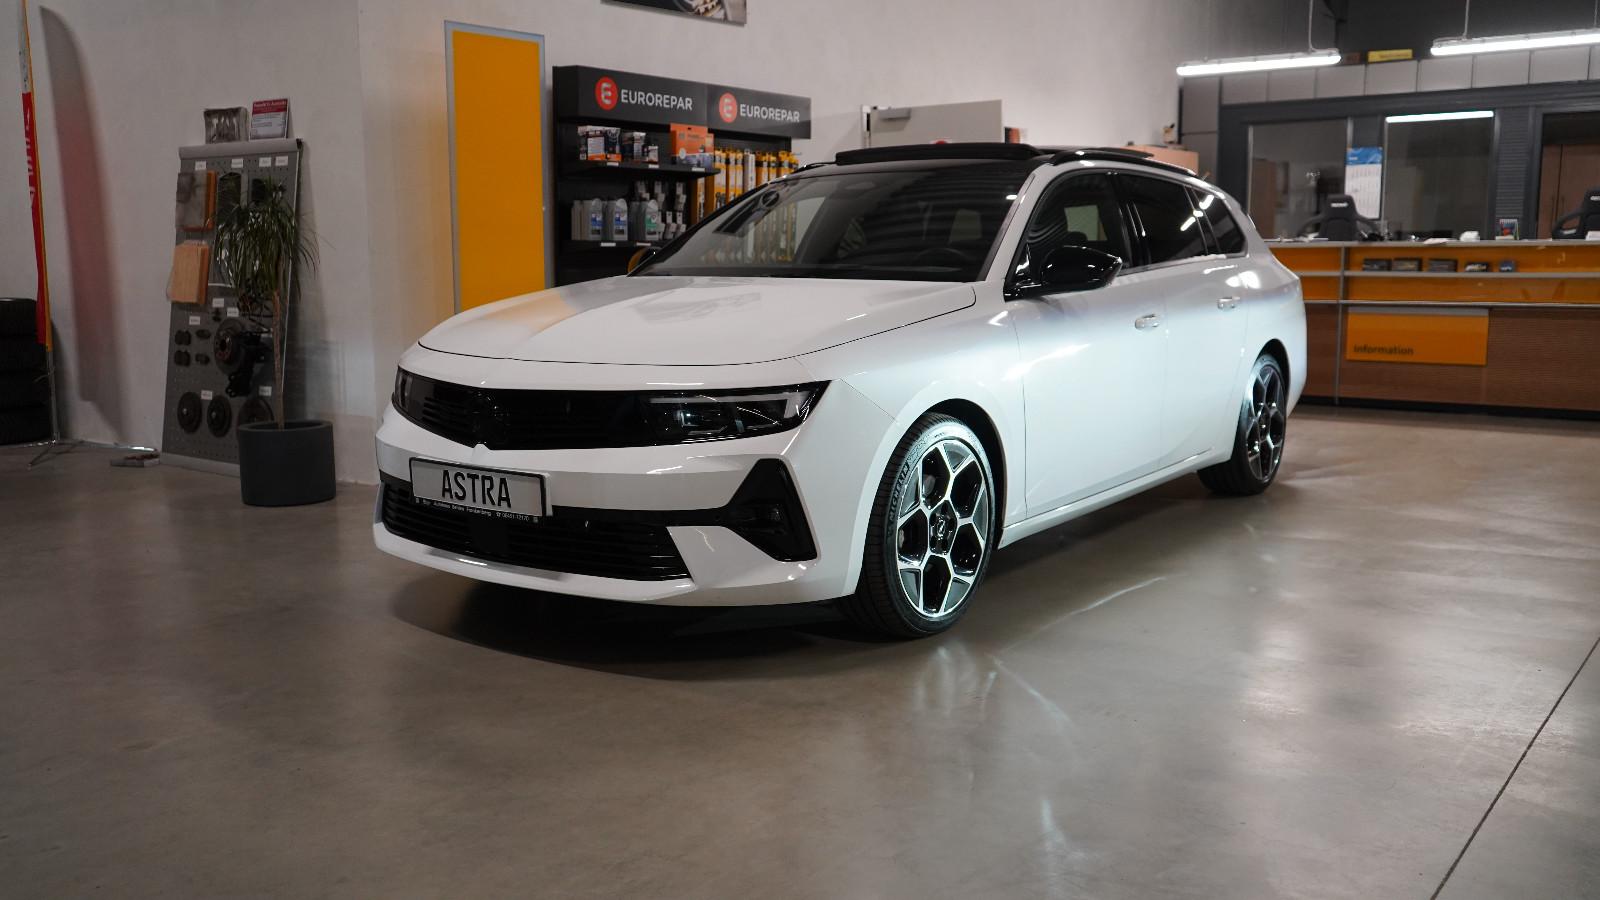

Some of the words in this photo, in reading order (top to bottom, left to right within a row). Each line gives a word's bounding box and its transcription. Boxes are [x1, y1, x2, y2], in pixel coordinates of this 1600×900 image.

[620, 89, 693, 111] EUROREPAR
[739, 104, 801, 123] EUROREPAR
[441, 469, 511, 508] ASTRA
